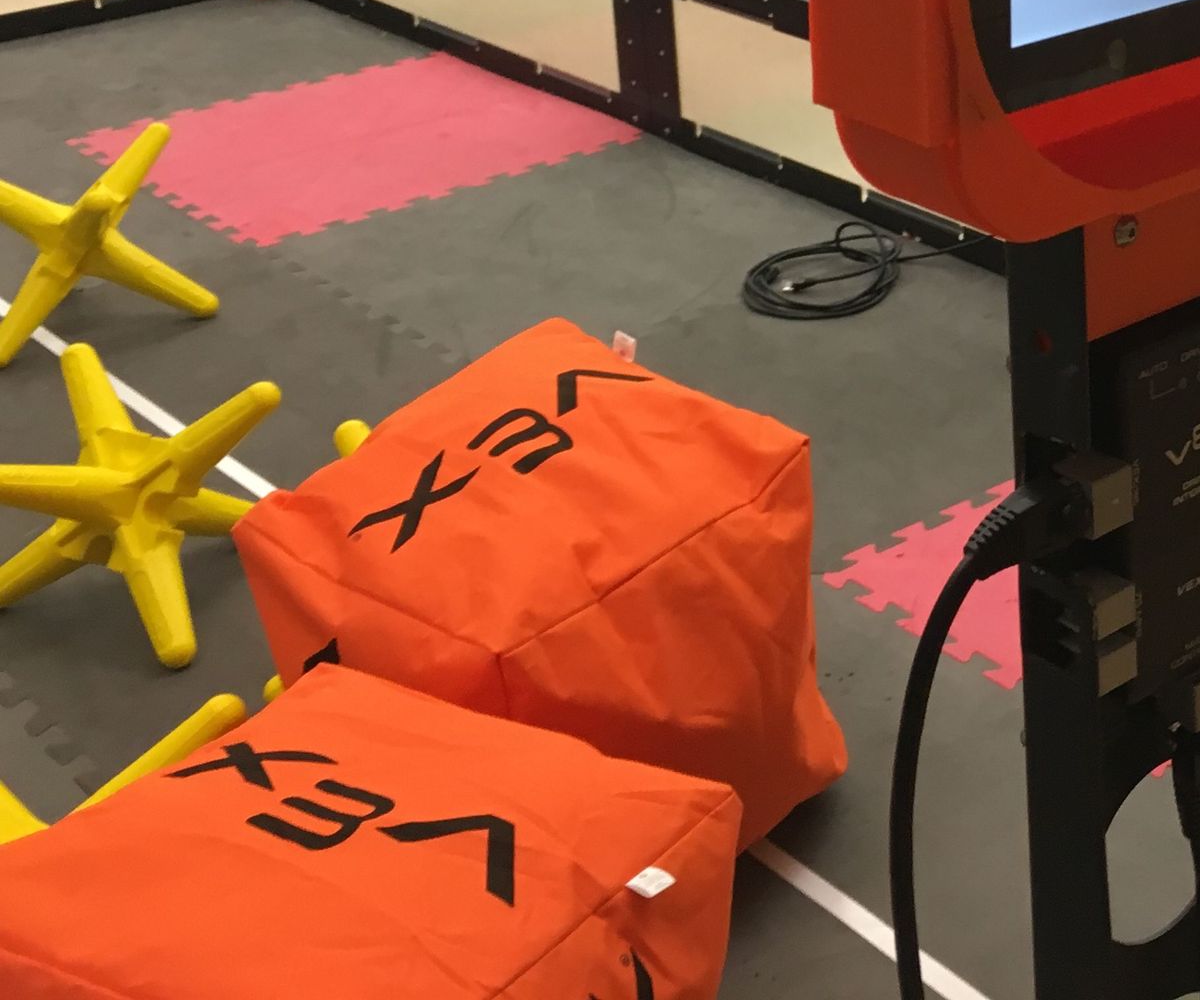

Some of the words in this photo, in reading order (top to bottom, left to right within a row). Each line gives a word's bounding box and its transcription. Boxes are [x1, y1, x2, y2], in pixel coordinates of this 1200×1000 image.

[1138, 360, 1169, 380] AUTO
[347, 368, 656, 555] VEX
[163, 741, 515, 908] VEX
